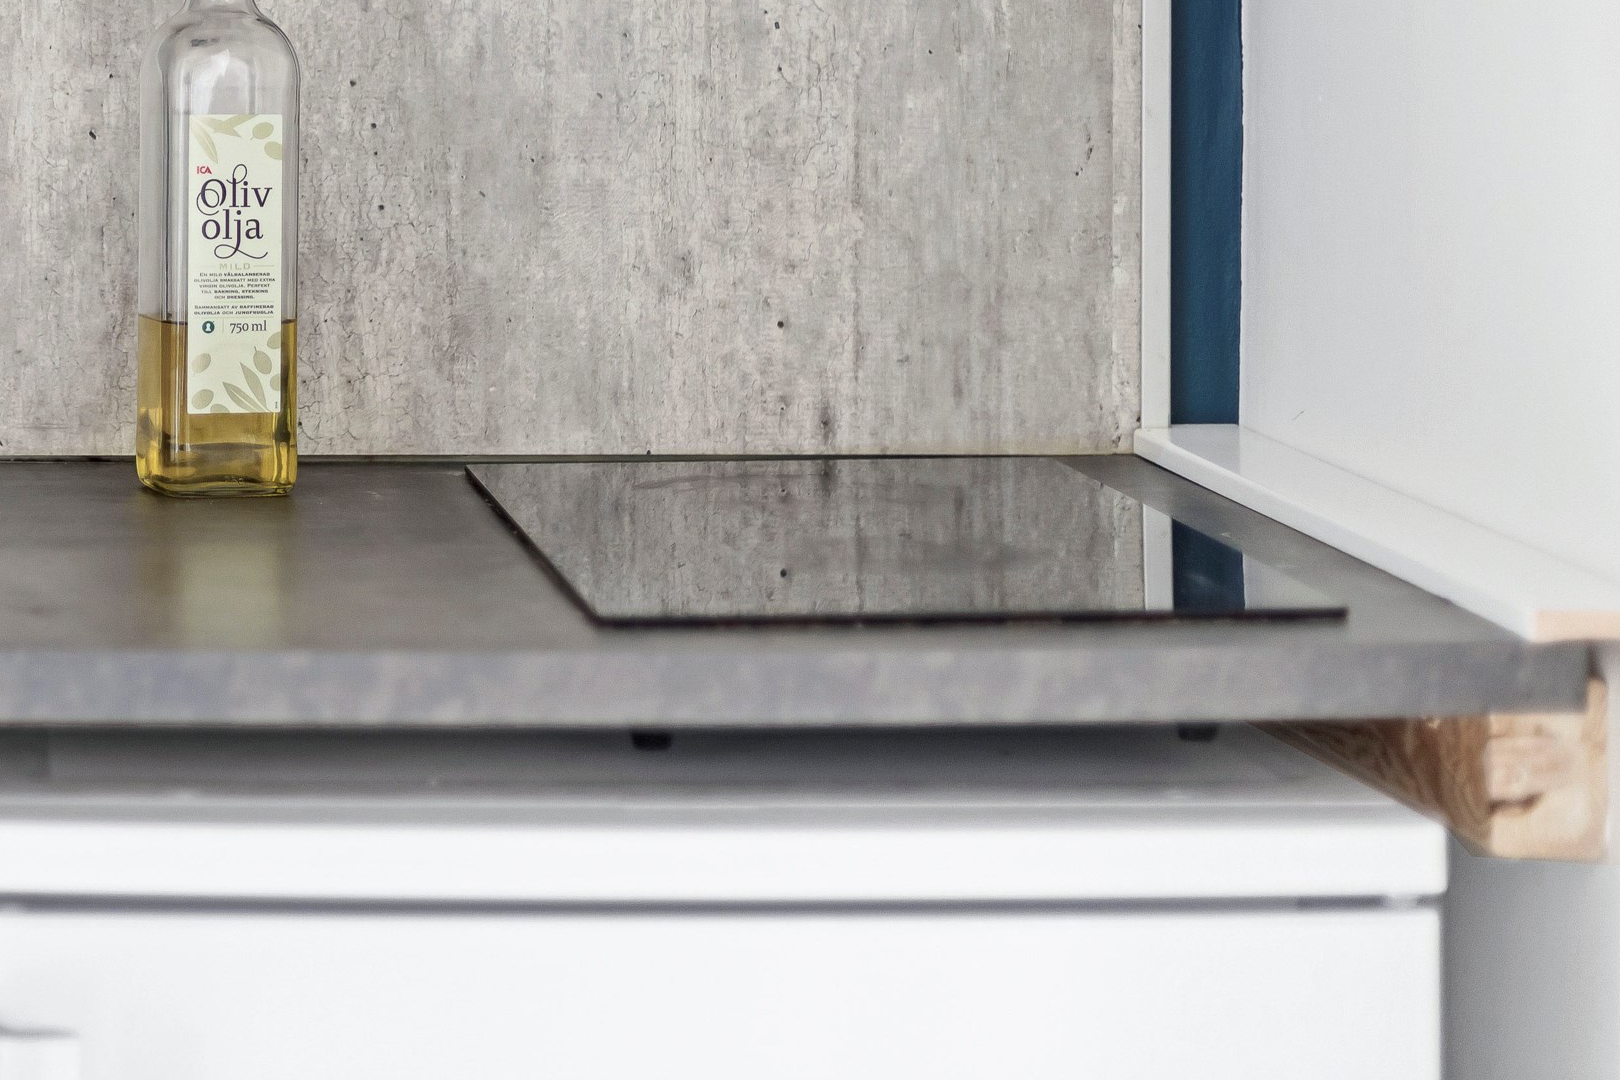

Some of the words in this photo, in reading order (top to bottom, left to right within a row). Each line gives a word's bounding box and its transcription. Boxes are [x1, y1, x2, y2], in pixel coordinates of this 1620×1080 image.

[196, 165, 212, 175] ICA
[196, 163, 273, 216] Oliv
[201, 208, 269, 260] olja
[219, 262, 251, 270] MILD
[229, 323, 249, 334] 750
[251, 320, 267, 332] ml
